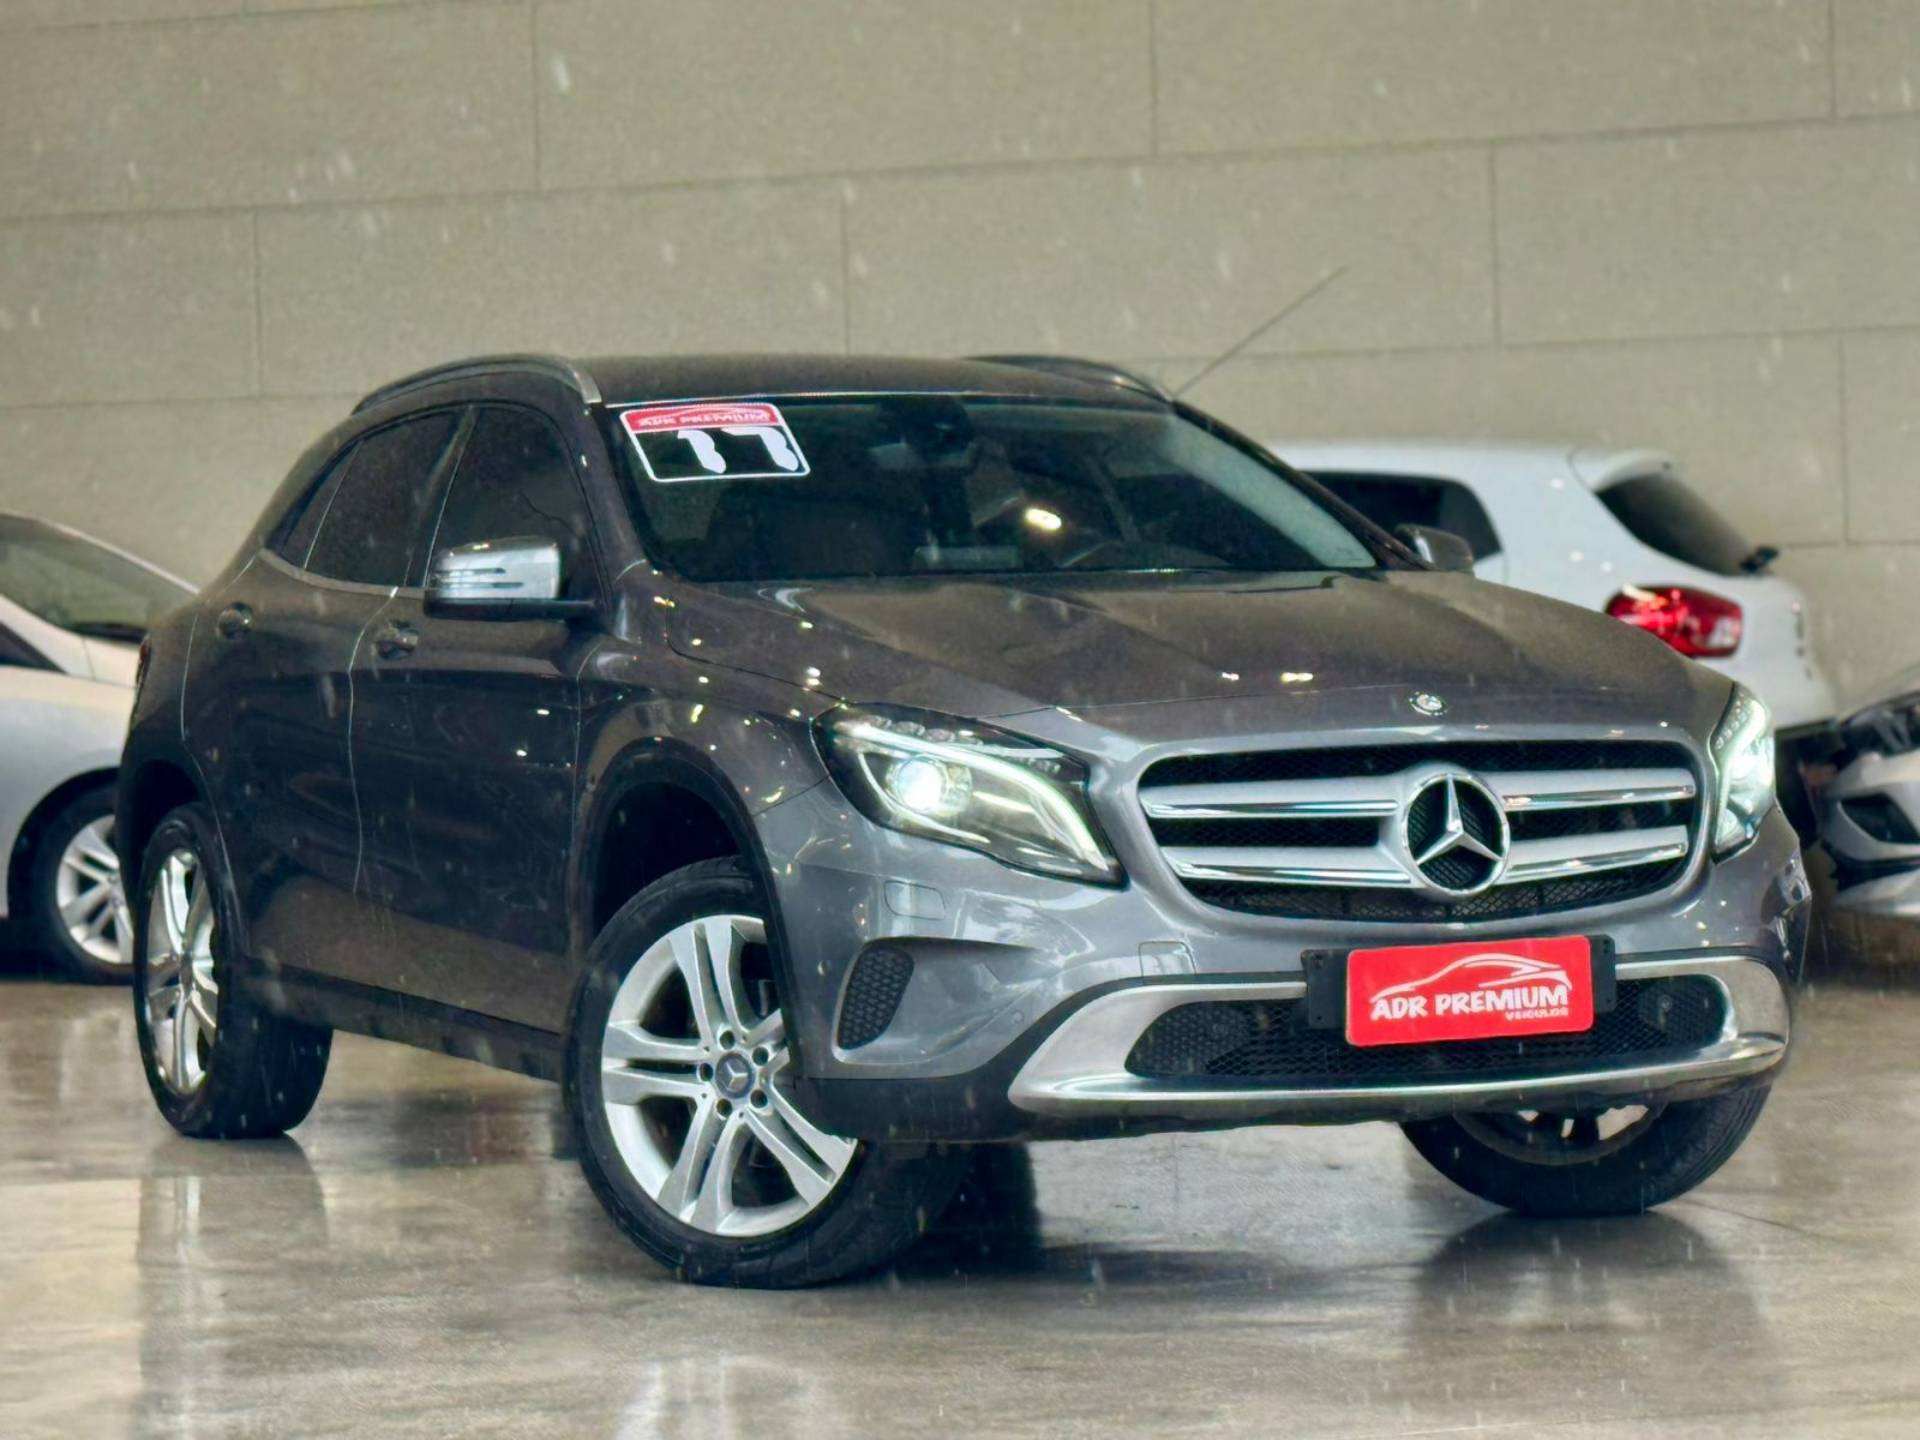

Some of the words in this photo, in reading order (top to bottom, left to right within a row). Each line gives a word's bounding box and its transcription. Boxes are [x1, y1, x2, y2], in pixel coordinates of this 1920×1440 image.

[680, 410, 771, 424] PREMIUM
[1370, 996, 1428, 1021] ADR
[1435, 985, 1569, 1016] PREMIUM
